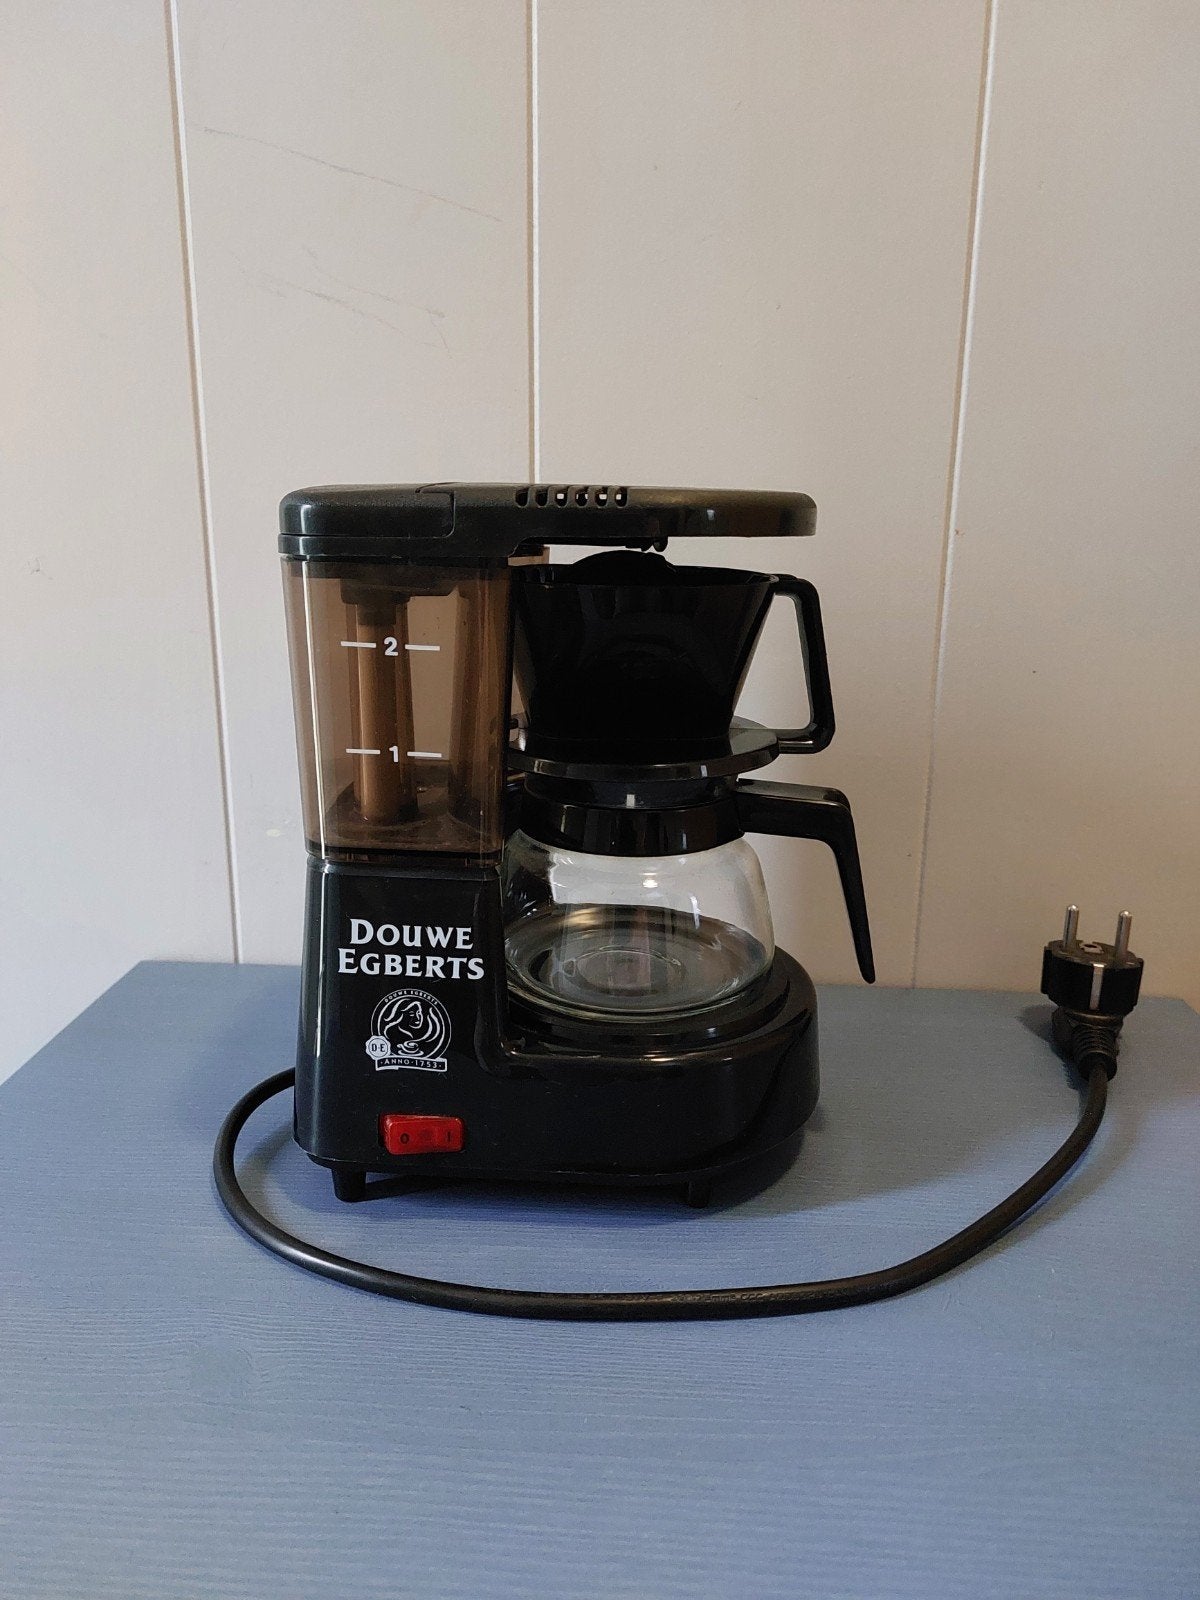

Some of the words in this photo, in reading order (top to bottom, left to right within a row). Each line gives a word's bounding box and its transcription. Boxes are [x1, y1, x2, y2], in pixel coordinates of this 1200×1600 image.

[384, 637, 398, 656] 2
[389, 745, 399, 763] 1
[350, 918, 473, 950] DOUWE
[338, 948, 485, 980] EGBERTS
